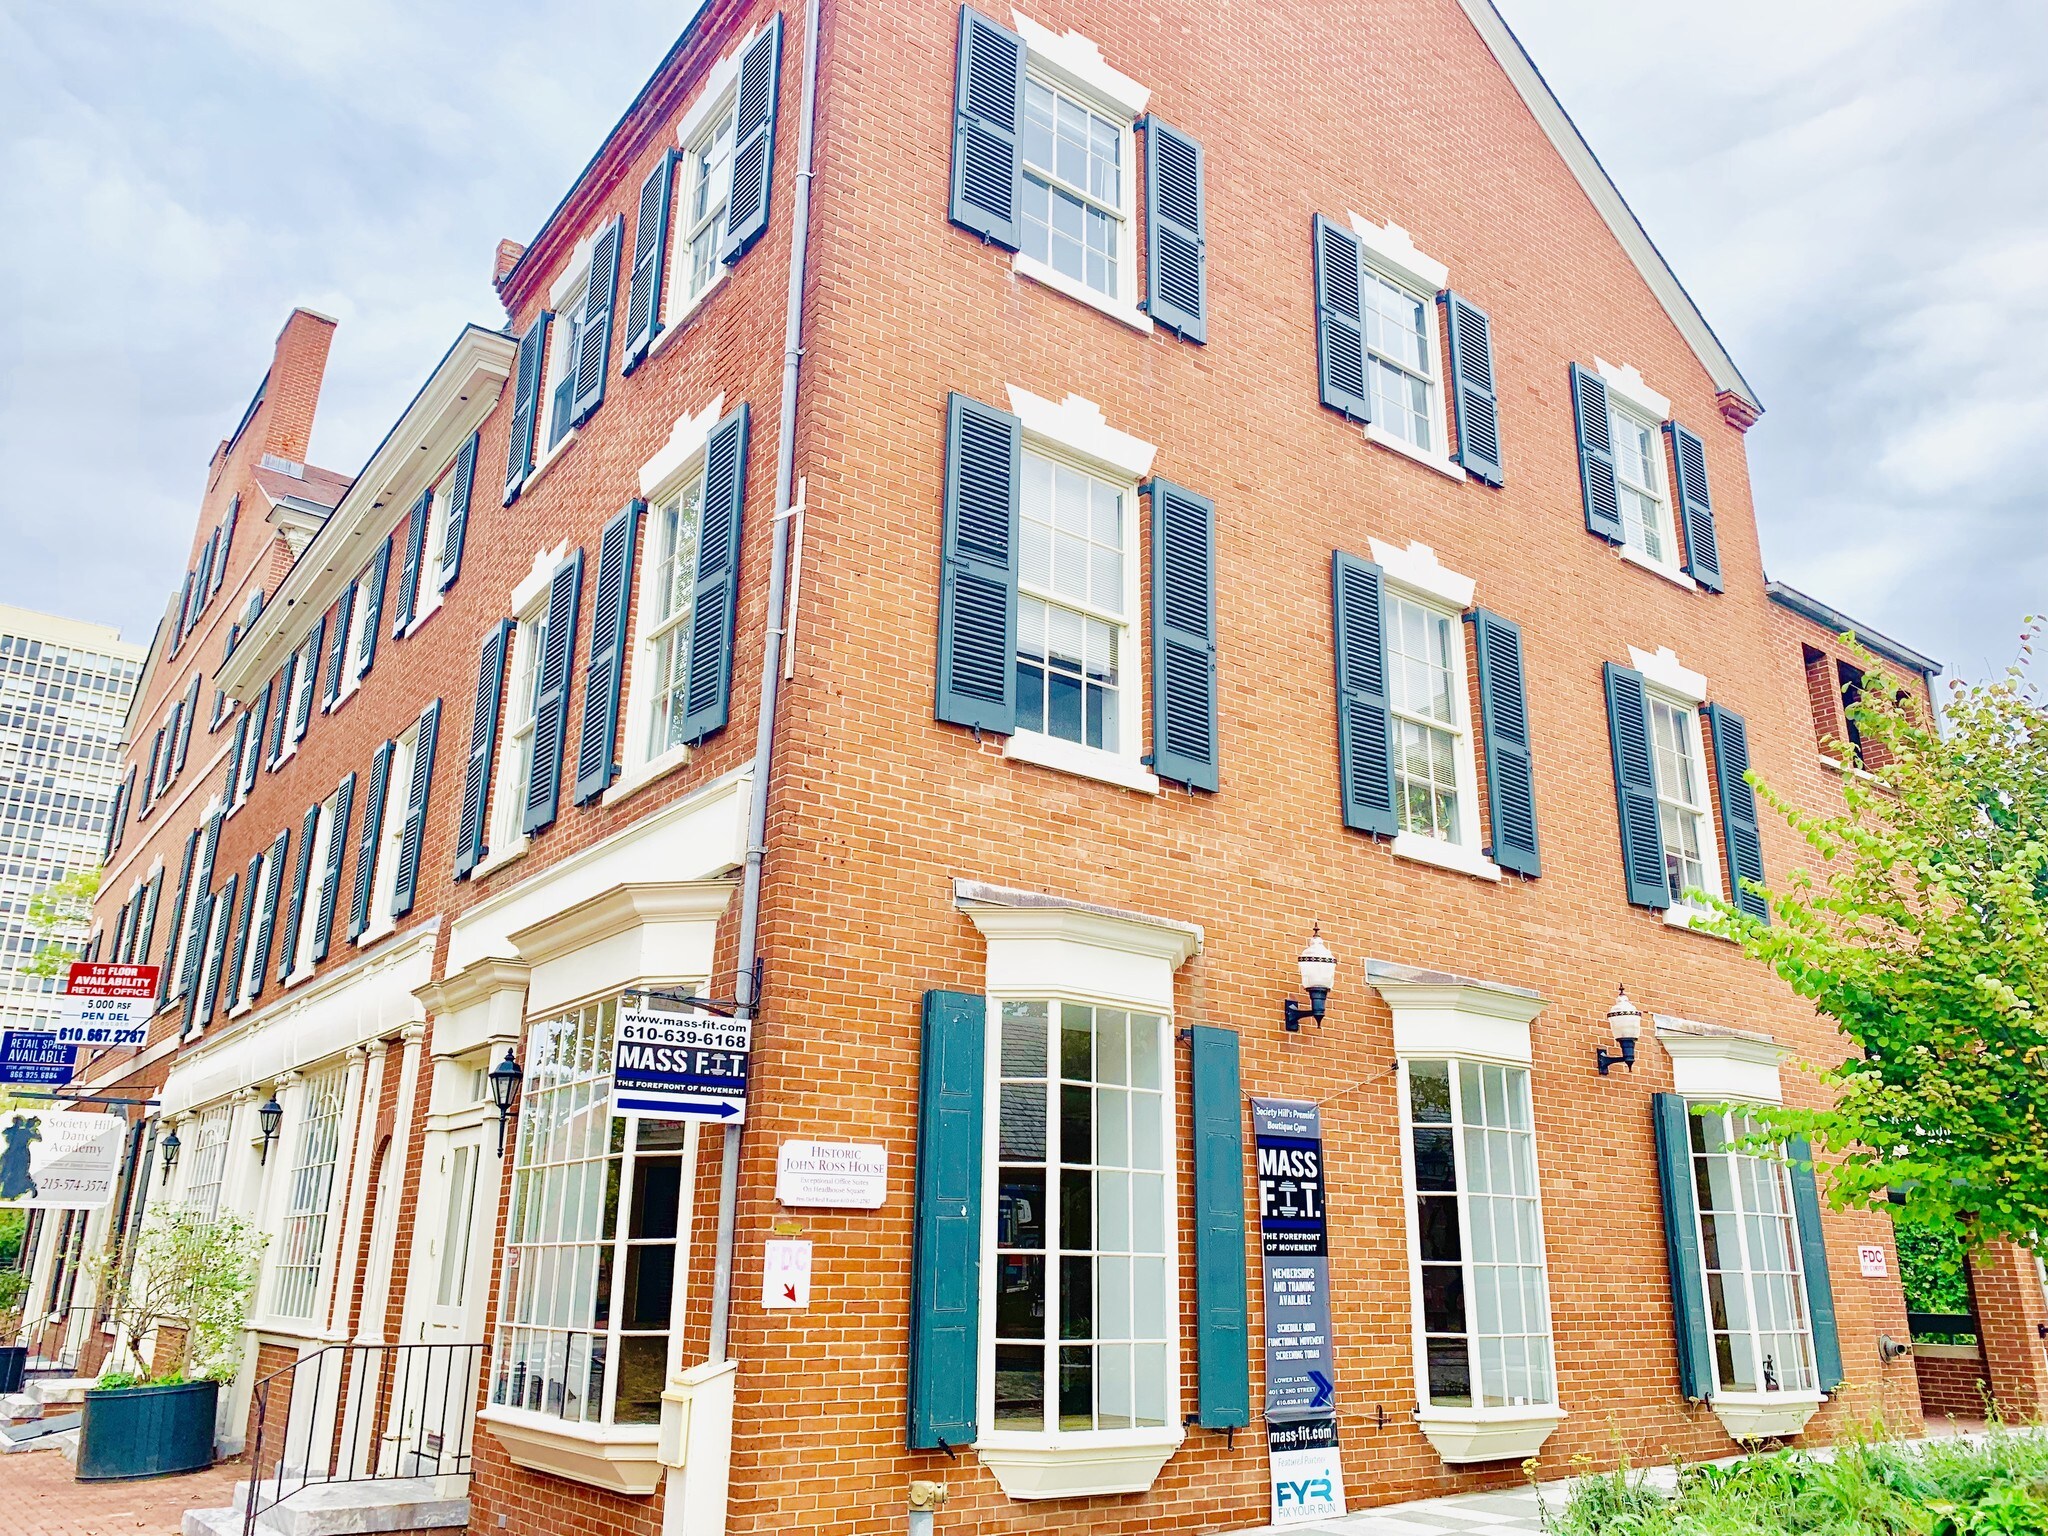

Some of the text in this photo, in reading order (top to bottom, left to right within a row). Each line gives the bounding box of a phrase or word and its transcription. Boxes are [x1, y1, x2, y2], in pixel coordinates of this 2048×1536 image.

[108, 967, 138, 976] FLOOR
[74, 976, 151, 987] AVAILABILITY
[108, 1013, 130, 1021] DEL
[625, 1014, 747, 1032] www.mass-fit.com
[59, 1028, 146, 1043] 610.667.2787
[624, 1026, 746, 1048] 610-639-6168
[10, 1038, 39, 1049] RETAIL
[8, 1049, 67, 1063] AVAILABLE
[618, 1045, 688, 1073] MASS
[636, 1081, 686, 1090] FOREFRONT
[700, 1086, 744, 1095] MOVEMENT
[1256, 1107, 1315, 1119] Society Hill's Premier
[49, 1118, 114, 1131] Society Hill
[1268, 1121, 1307, 1133] Boutique Gym
[61, 1131, 97, 1141] Dance
[50, 1143, 104, 1156] Academy
[812, 1146, 861, 1160] HISTORIC
[1259, 1148, 1318, 1178] MASS
[40, 1178, 108, 1192] 215-574-3574
[800, 1177, 833, 1186] Exceptional
[846, 1187, 865, 1196] Square
[1862, 1250, 1882, 1263] FDC
[1272, 1268, 1314, 1279] MEMBERSHIPS
[1274, 1281, 1315, 1292] AND TRAINING
[1279, 1295, 1312, 1306] AVAILABLE
[1271, 1426, 1332, 1443] mass-fit.com
[1276, 1479, 1333, 1507] FYR
[1279, 1503, 1336, 1518] FIX YOUR RUN
